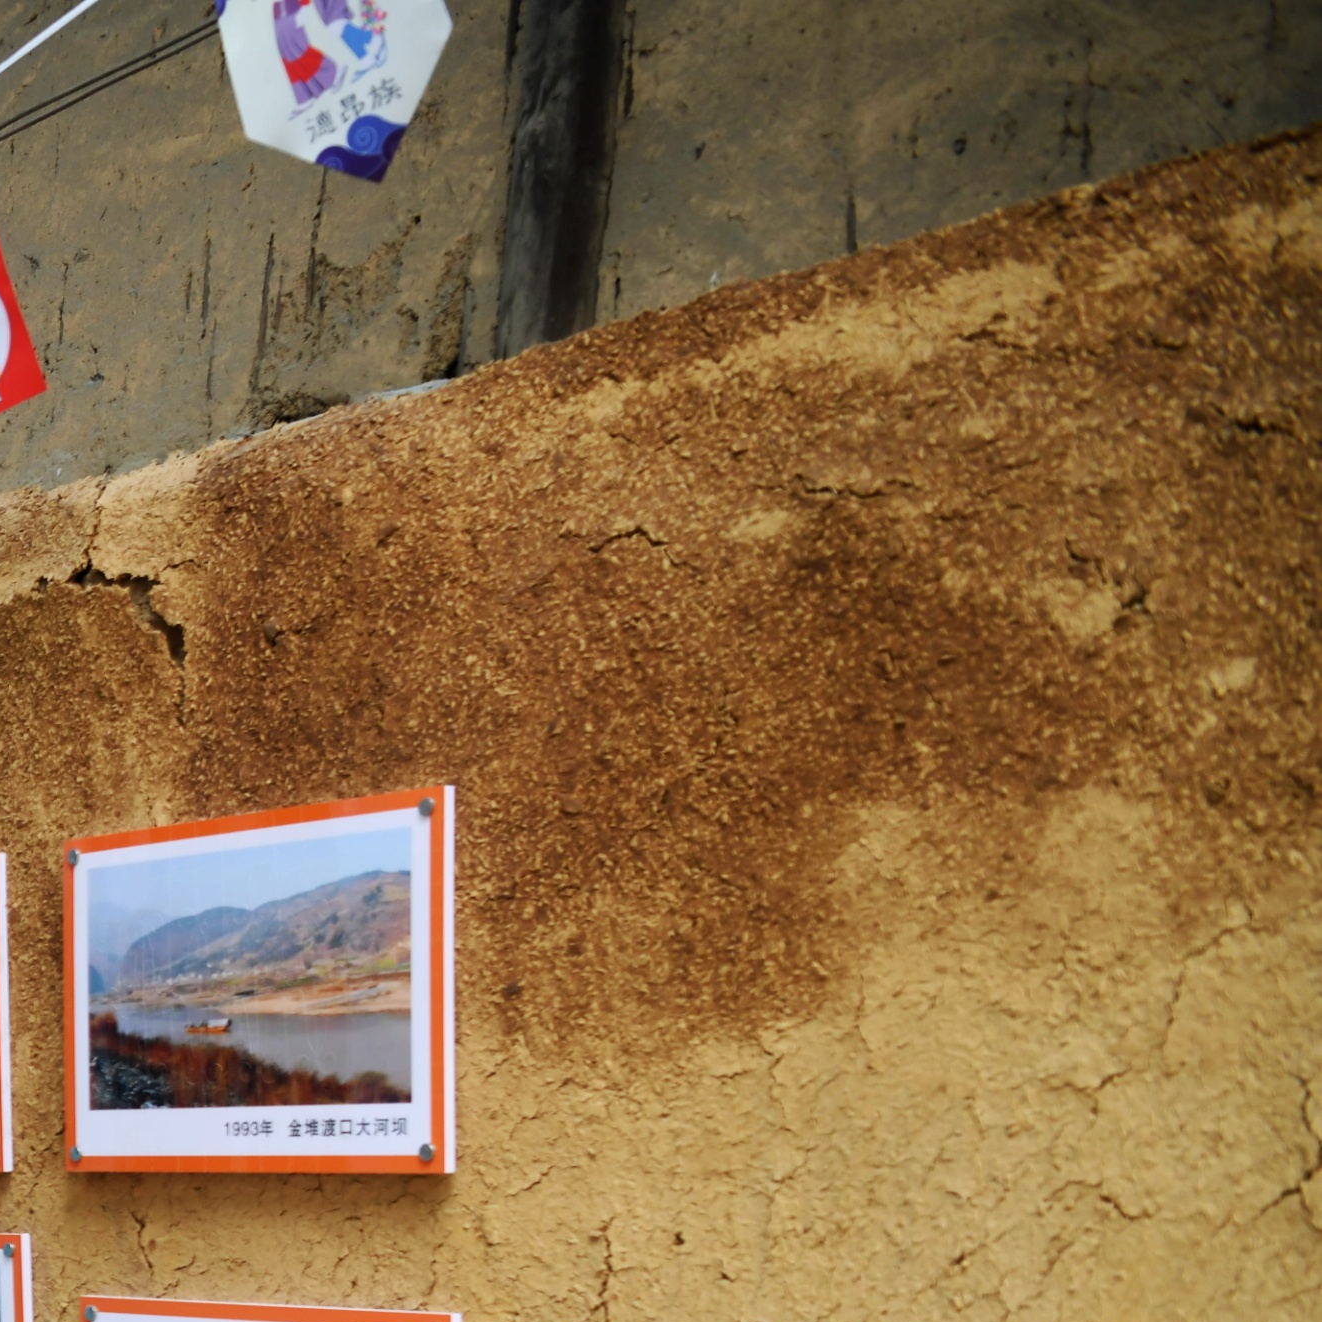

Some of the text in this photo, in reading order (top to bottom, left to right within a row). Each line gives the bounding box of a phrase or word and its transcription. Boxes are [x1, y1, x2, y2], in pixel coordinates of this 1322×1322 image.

[224, 1117, 408, 1138] 1993年 金堆渡口大河坝
